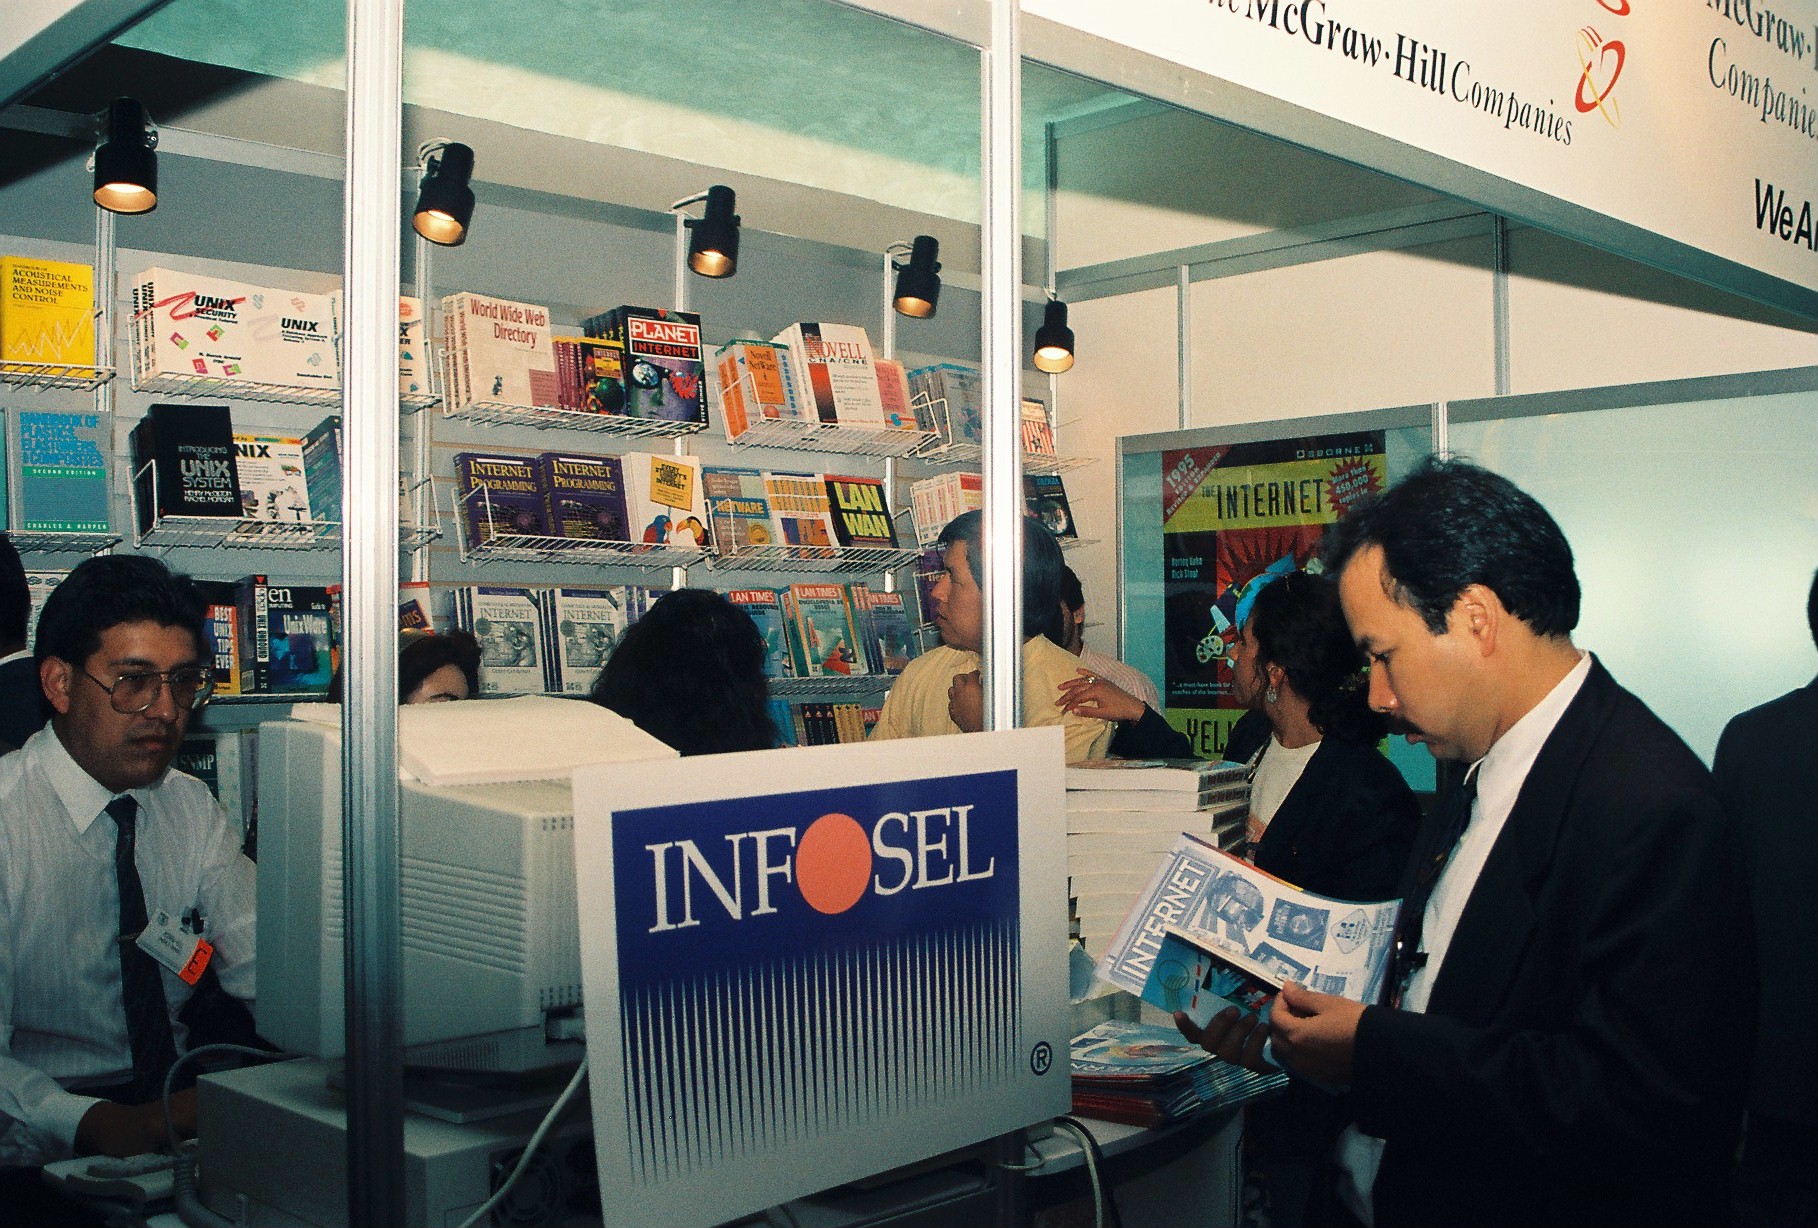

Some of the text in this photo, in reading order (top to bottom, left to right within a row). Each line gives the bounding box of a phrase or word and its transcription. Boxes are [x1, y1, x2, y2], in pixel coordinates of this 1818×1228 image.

[1709, 37, 1818, 138] Companie
[1452, 60, 1574, 147] Companies
[12, 268, 74, 282] ACOUSTICAL
[12, 276, 88, 292] MEASUREMENTS
[12, 285, 64, 297] AND NOISE
[12, 292, 58, 304] CONTROL
[194, 294, 236, 312] UNIX
[195, 307, 238, 319] SECURITY
[470, 299, 545, 327] World Wide Web
[281, 317, 319, 332] UNIX
[632, 321, 698, 343] PLANET
[494, 322, 537, 349] Directory
[634, 342, 697, 357] INTERNET
[805, 336, 867, 359] NOVELL
[178, 445, 228, 454] INTRODUCING
[235, 443, 271, 458] NIX
[1296, 446, 1361, 459] OSBORNE
[180, 459, 231, 478] UNIX
[469, 460, 532, 478] INTERNET
[553, 460, 611, 478] INTERNET
[1166, 453, 1194, 487] 1995
[183, 477, 232, 489] SYSTEM
[470, 476, 536, 492] PROGRAMMING
[553, 475, 615, 491] PROGRAMMING
[834, 481, 883, 511] LAN
[1217, 478, 1324, 519] INTERNET
[842, 513, 890, 538] WAN
[730, 591, 774, 603] LAN TIMES
[800, 587, 838, 599] LAN TIMES
[214, 607, 232, 621] BEST
[480, 608, 531, 621] INTERNET
[563, 609, 612, 622] INTERNET
[213, 622, 233, 637] UNIX
[283, 614, 327, 634] UnixWare
[215, 655, 234, 669] EVER
[645, 804, 995, 934] INFOSEL
[1119, 858, 1209, 980] INTERNET
